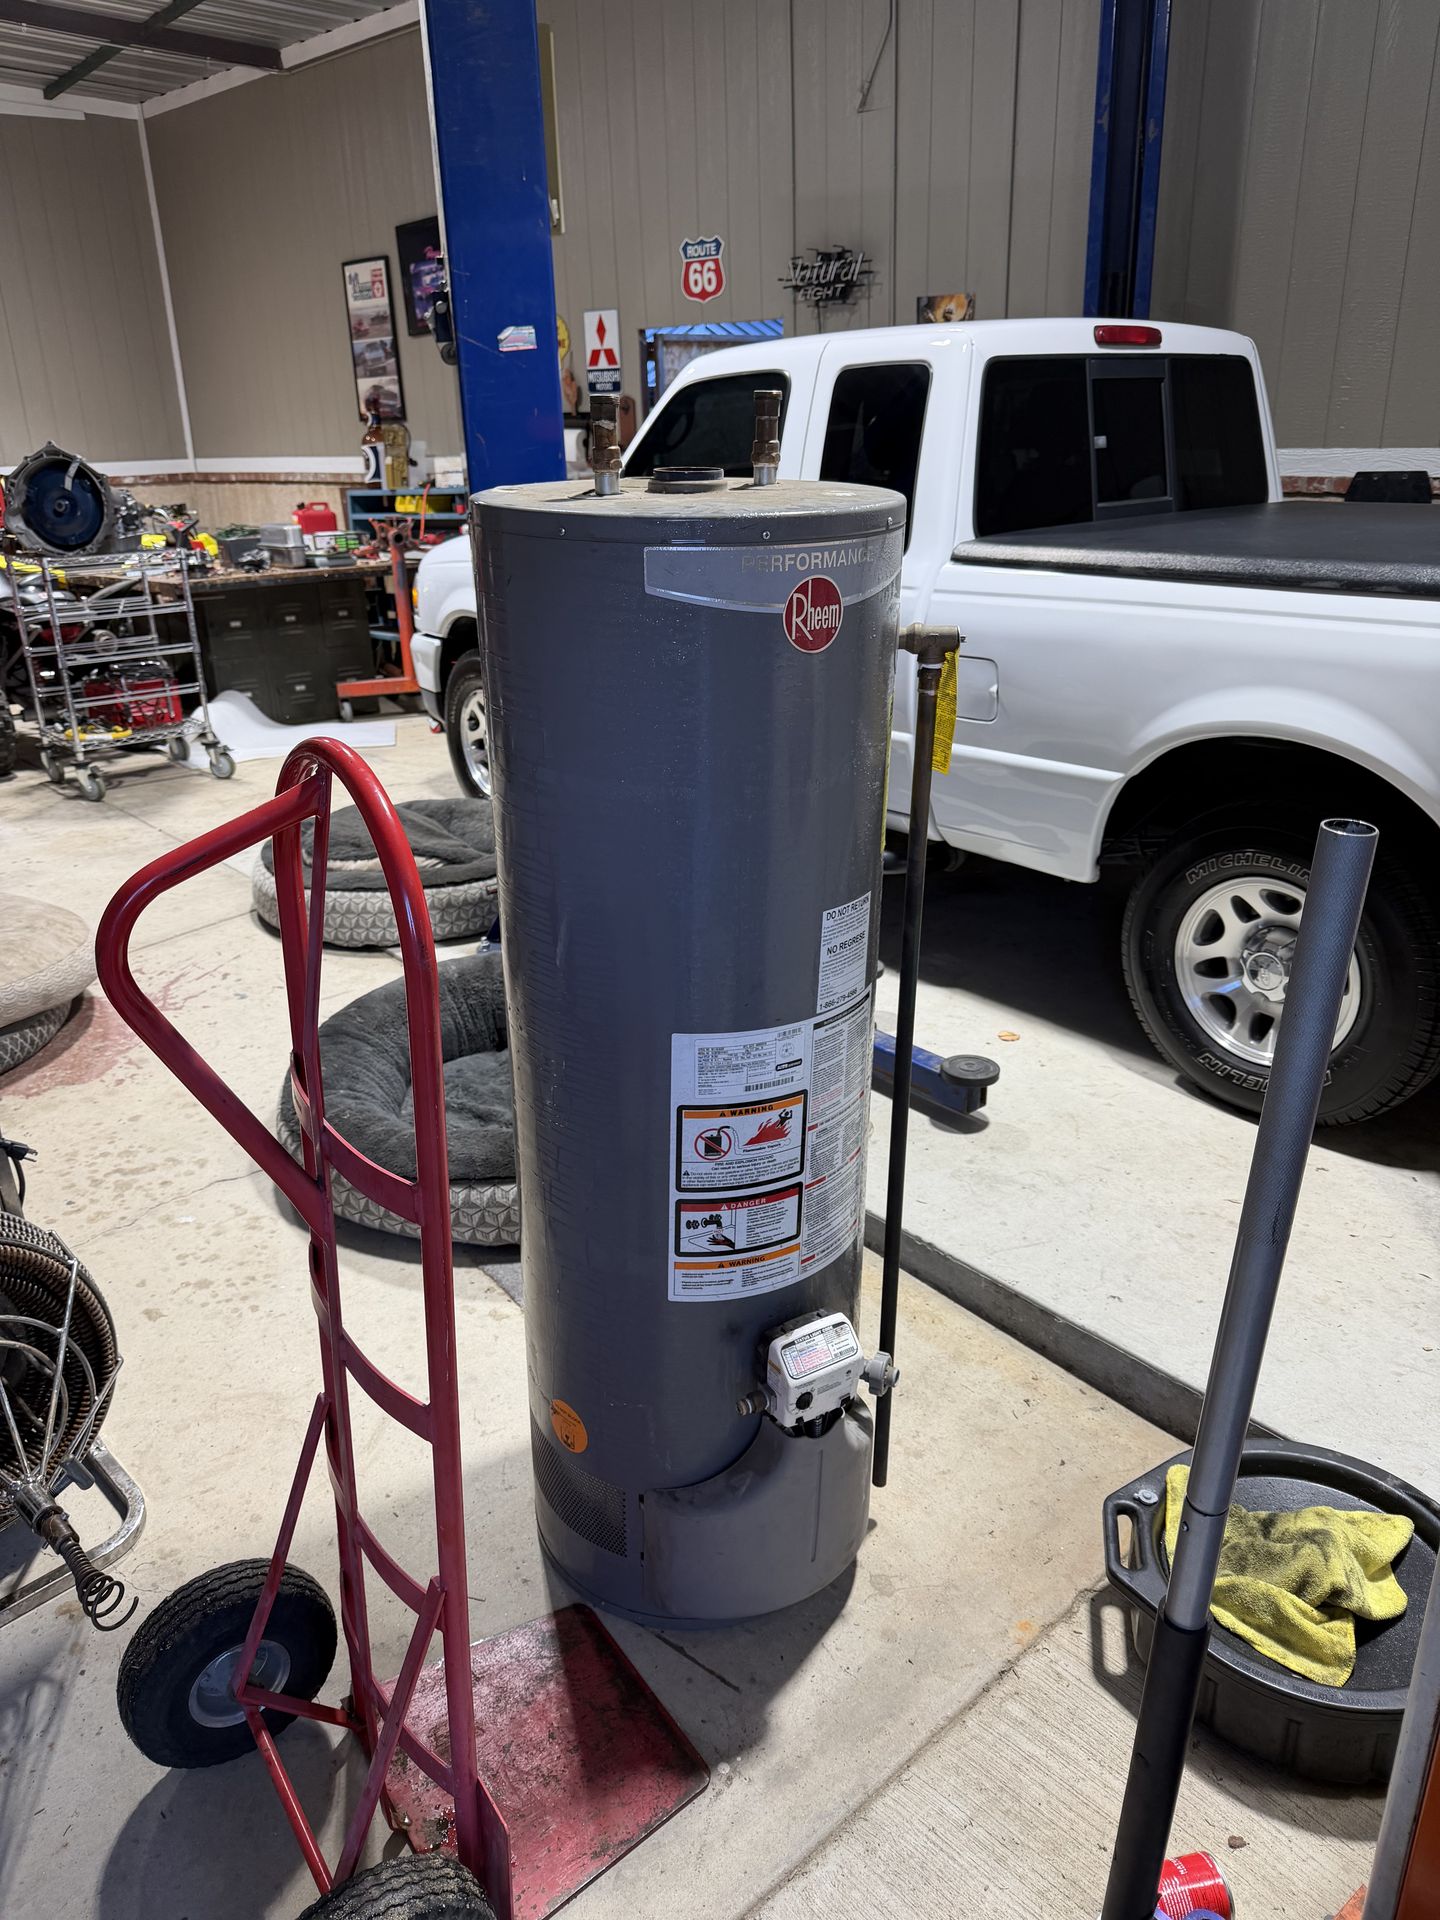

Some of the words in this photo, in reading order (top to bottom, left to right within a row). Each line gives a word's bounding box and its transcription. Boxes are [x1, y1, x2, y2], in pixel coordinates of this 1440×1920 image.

[686, 242, 717, 258] ROUTE
[688, 260, 717, 294] 66
[789, 252, 865, 285] Natural
[799, 283, 845, 301] LIGHT
[741, 548, 874, 573] PERFORMANCE
[791, 579, 839, 641] Rheem
[826, 910, 836, 921] DO
[837, 905, 850, 918] NOT
[826, 944, 838, 956] NO
[839, 930, 866, 951] REGRESE
[730, 1104, 774, 1117] WARNING
[731, 1198, 766, 1209] DANGER
[729, 1256, 765, 1268] WARNING
[795, 1334, 810, 1344] STATUS
[810, 1330, 821, 1339] LIGHT
